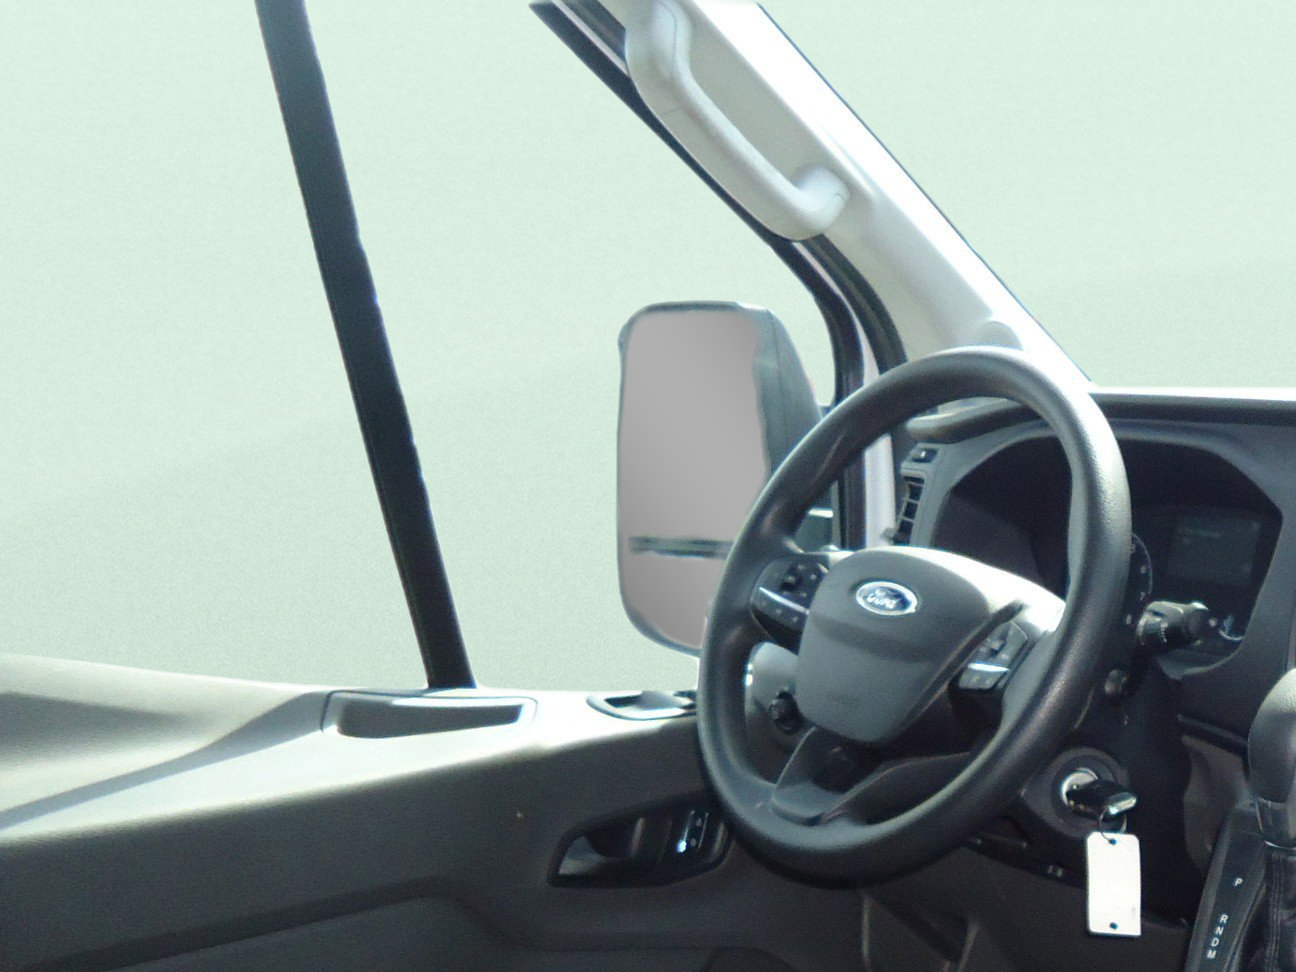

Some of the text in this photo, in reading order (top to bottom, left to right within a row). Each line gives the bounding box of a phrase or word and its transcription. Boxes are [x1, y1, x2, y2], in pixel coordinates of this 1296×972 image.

[1234, 877, 1243, 887] P
[1220, 914, 1229, 924] R
[1215, 926, 1224, 935] N
[1211, 937, 1220, 947] D
[1206, 949, 1217, 959] M
